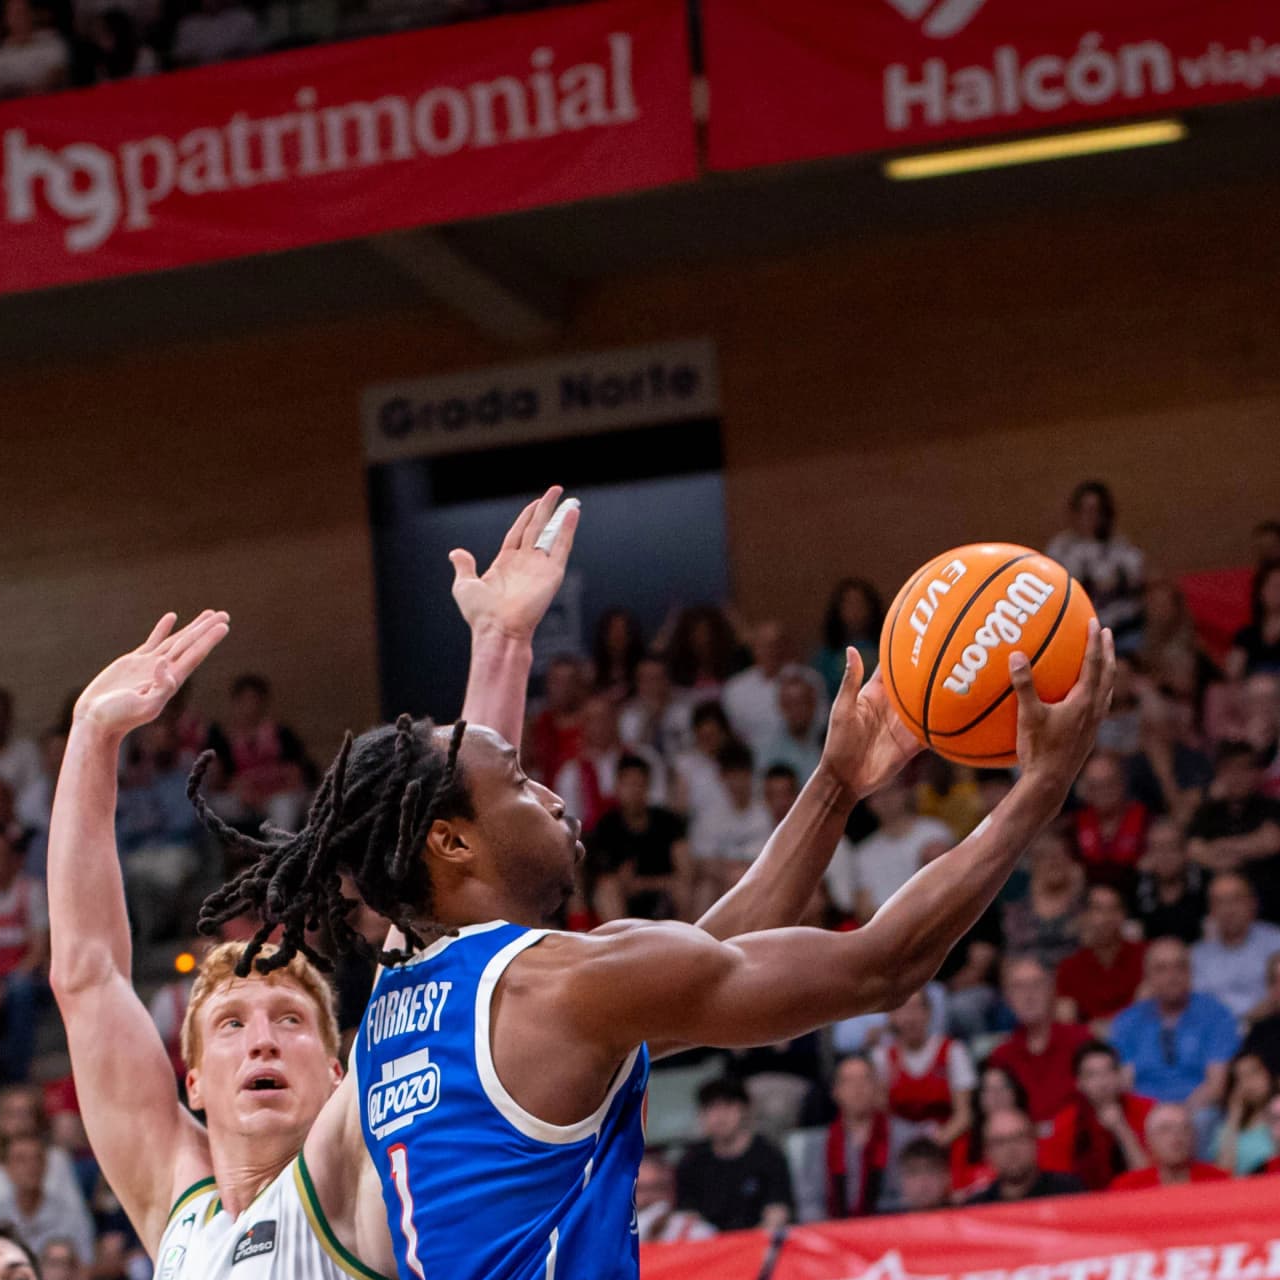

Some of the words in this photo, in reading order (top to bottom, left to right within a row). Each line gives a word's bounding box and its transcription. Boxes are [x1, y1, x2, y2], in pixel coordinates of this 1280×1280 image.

[883, 30, 1174, 130] Halcón
[379, 389, 539, 440] Grada
[560, 364, 700, 411] Norte
[943, 572, 1055, 695] Wilson
[367, 981, 452, 1052] FORREST
